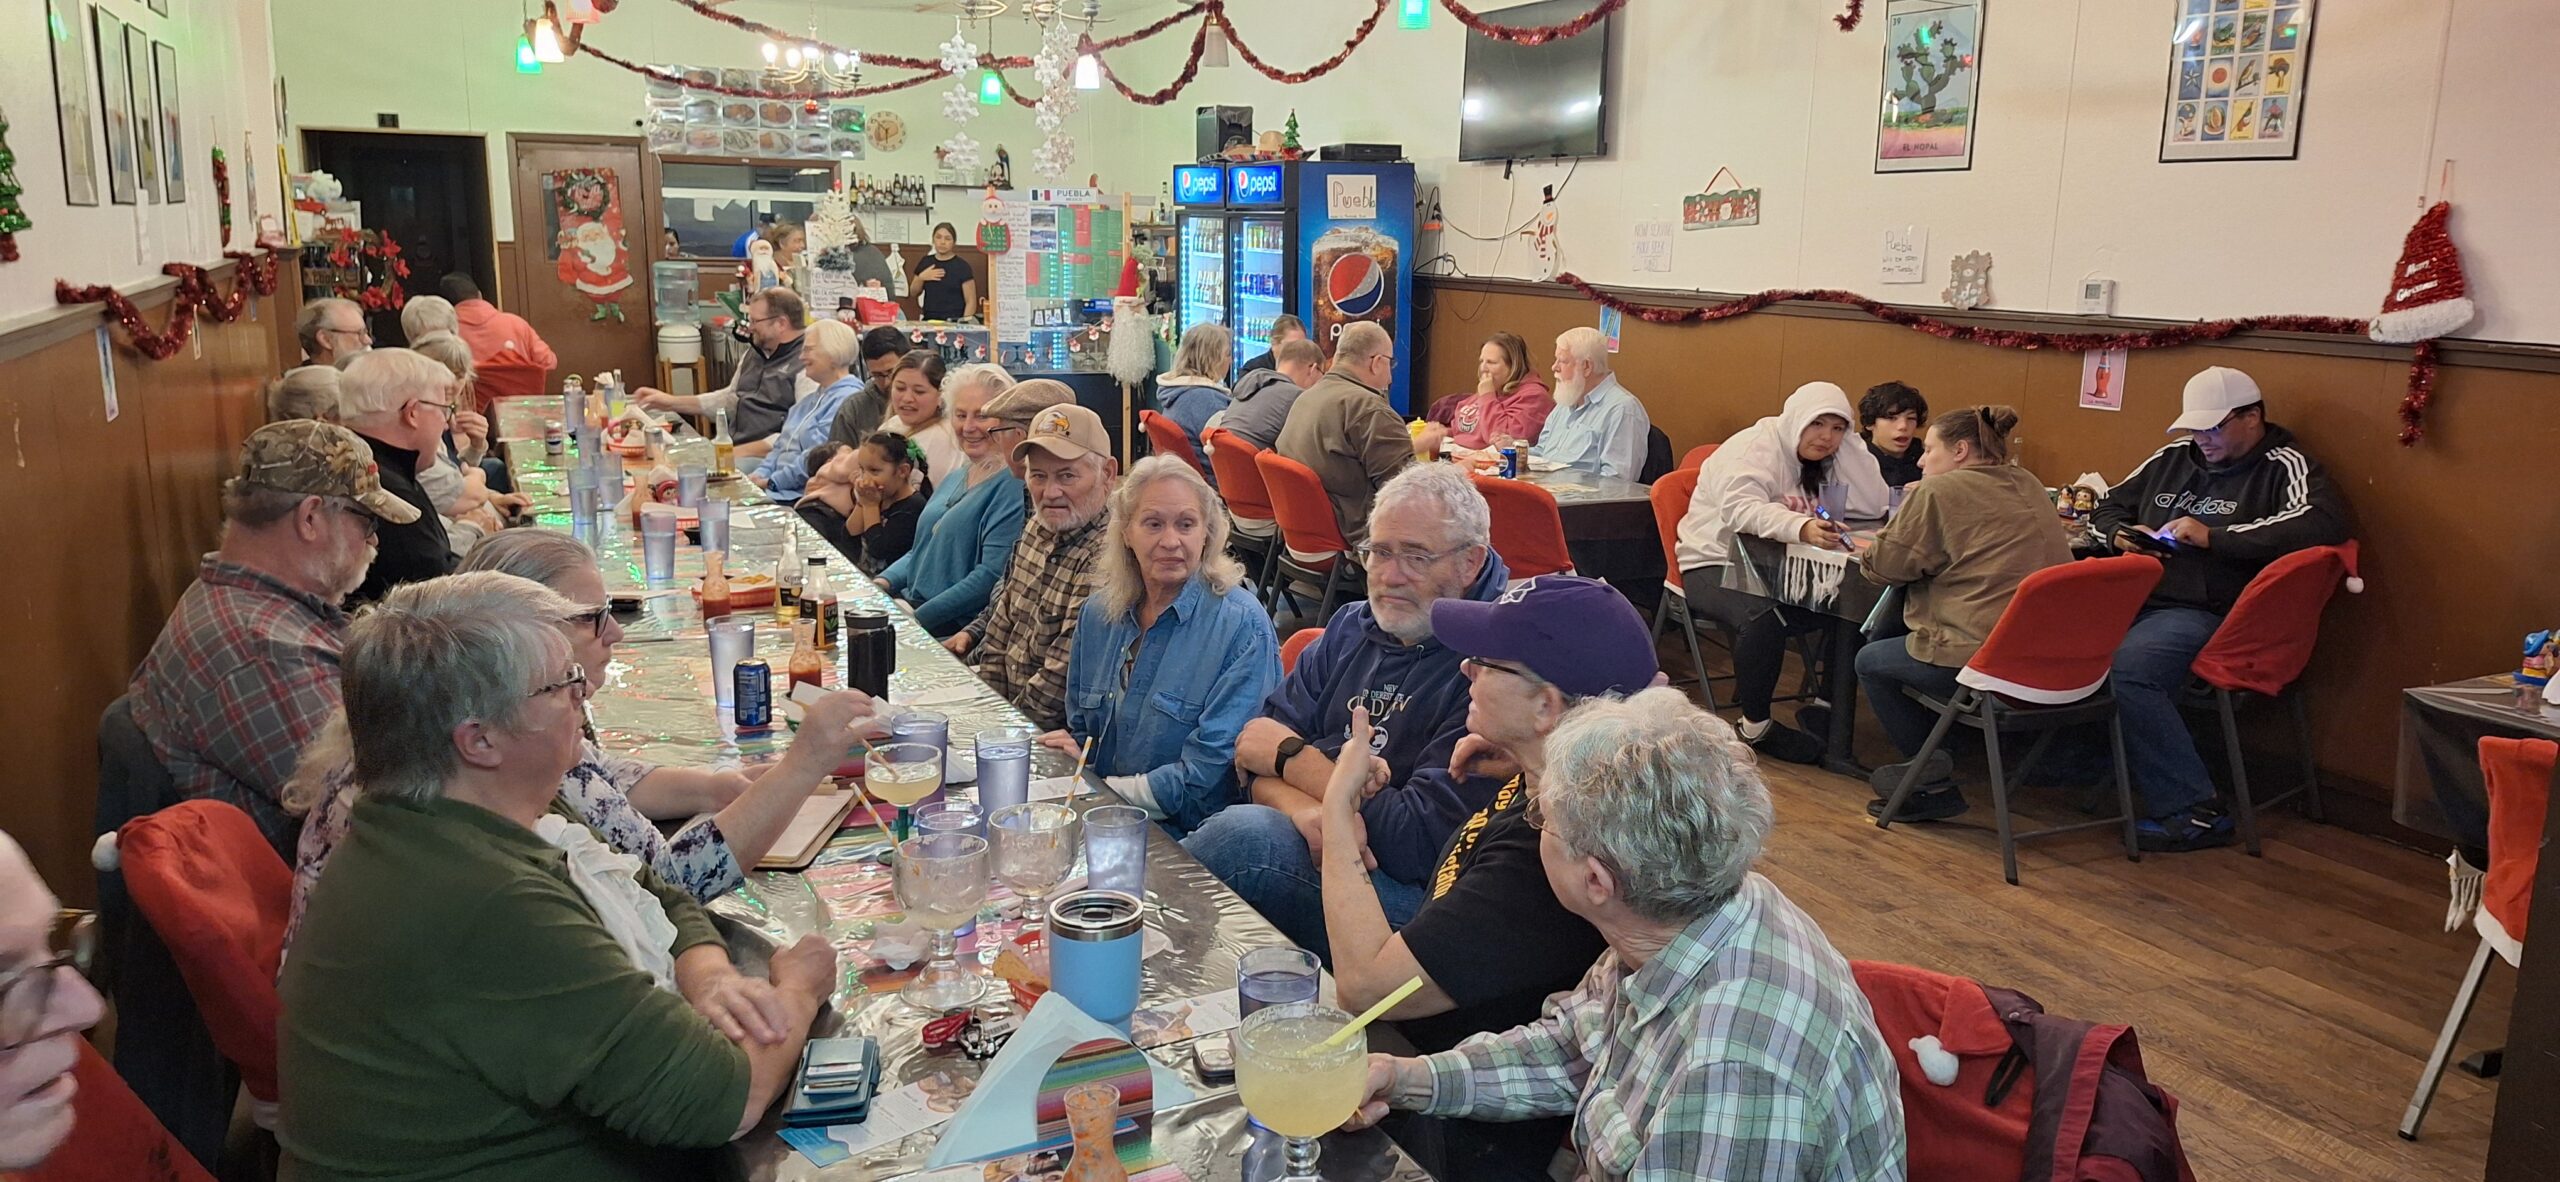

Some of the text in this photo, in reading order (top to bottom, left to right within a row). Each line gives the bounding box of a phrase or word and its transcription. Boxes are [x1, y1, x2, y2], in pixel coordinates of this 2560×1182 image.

[1892, 17, 1901, 26] 39
[1902, 143, 1939, 152] EL NOPAL
[1192, 173, 1217, 196] pepsi
[1249, 171, 1277, 197] pepsi
[1056, 189, 1091, 197] PUEBLA
[2154, 490, 2238, 515] adidas
